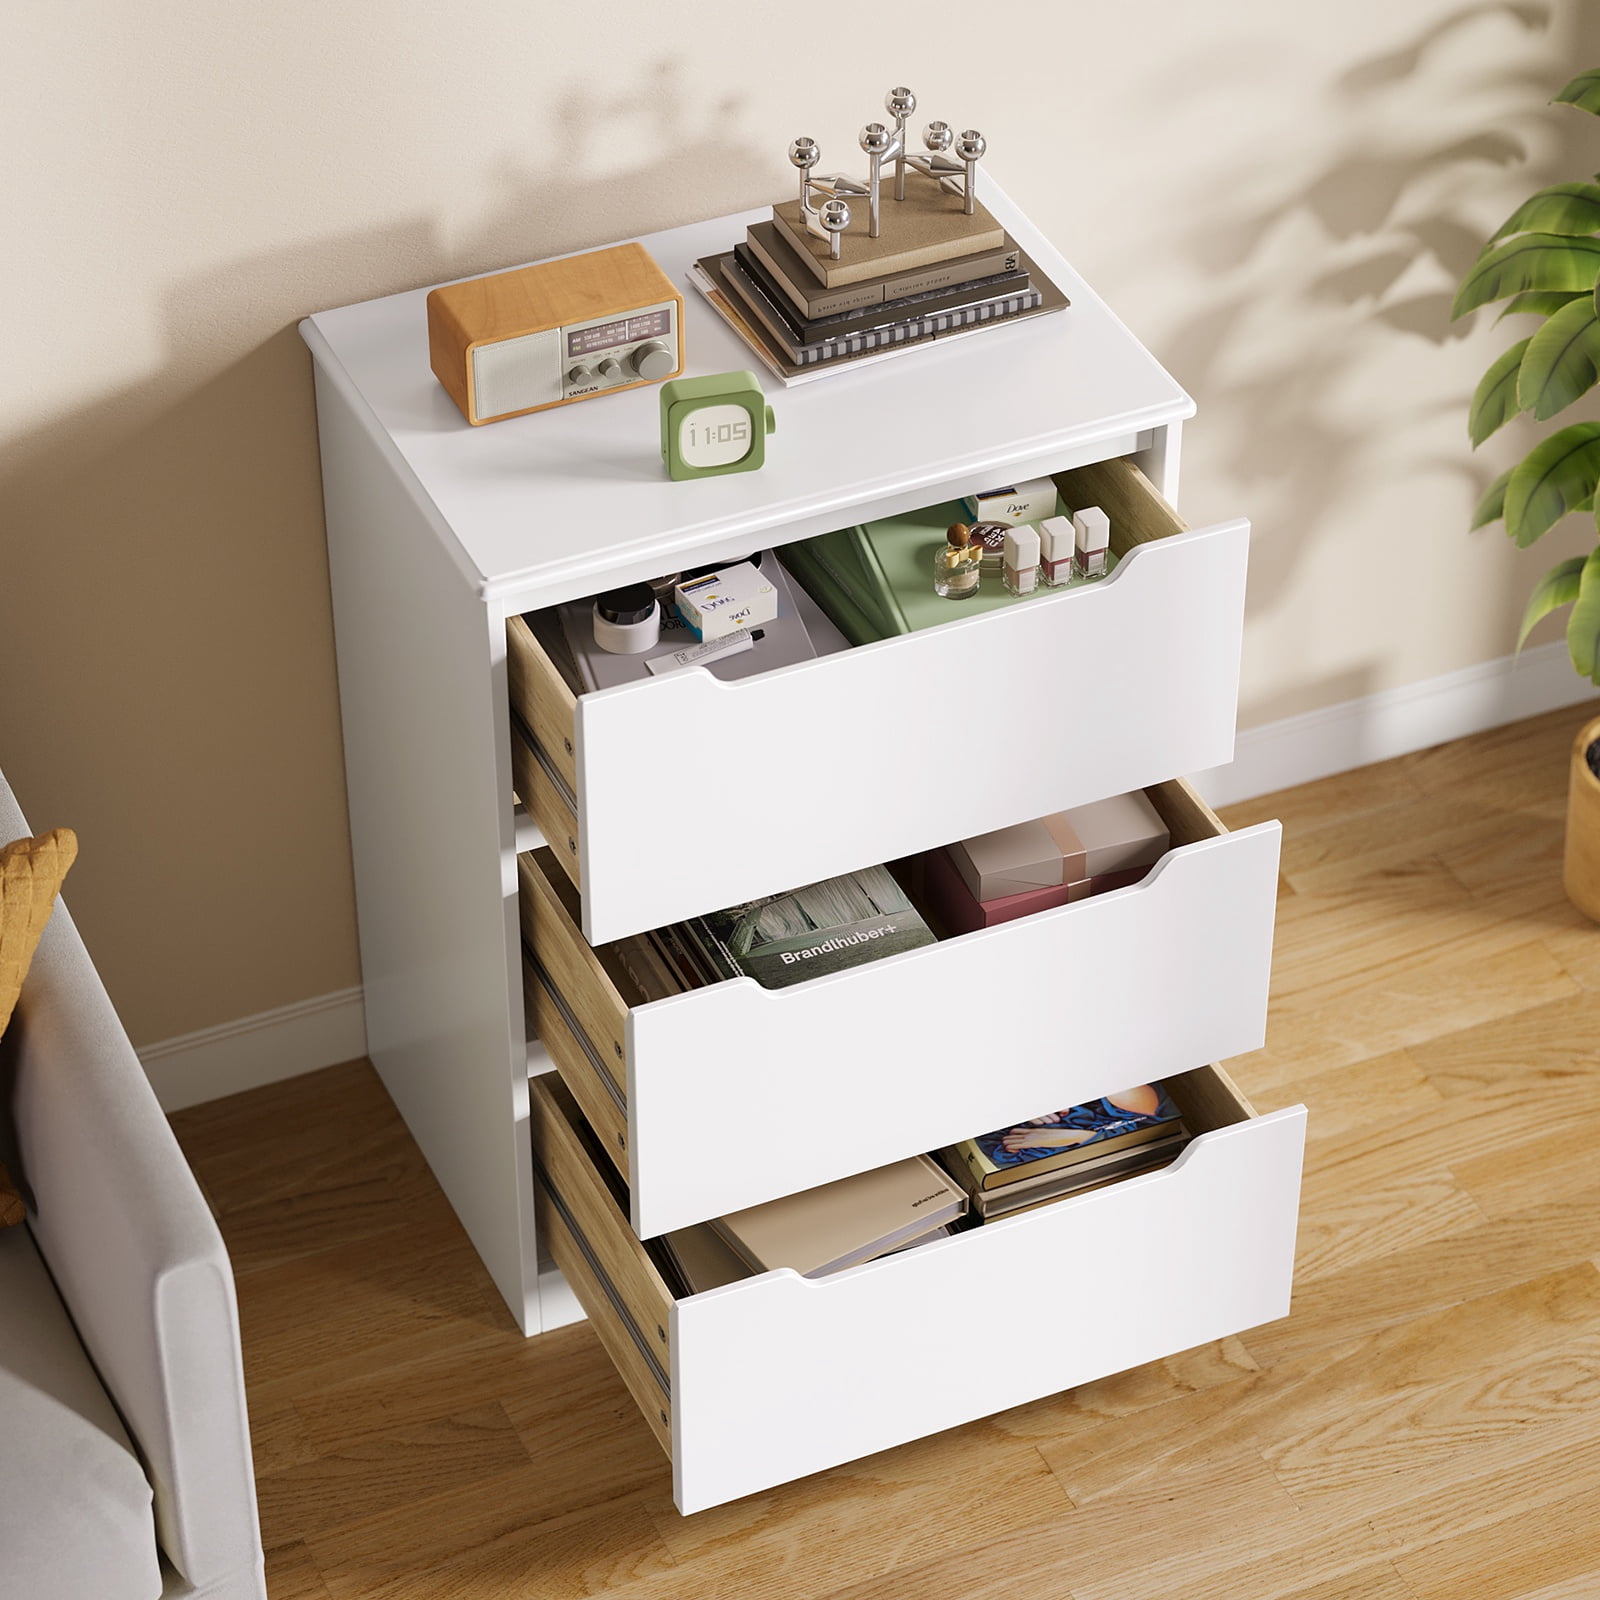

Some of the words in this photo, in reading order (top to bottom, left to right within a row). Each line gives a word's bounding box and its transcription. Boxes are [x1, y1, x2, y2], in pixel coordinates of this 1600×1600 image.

[568, 385, 599, 397] SANGEAN
[690, 421, 747, 447] 11:05
[1006, 503, 1030, 514] Dove
[780, 922, 898, 966] Brandlhuber+
